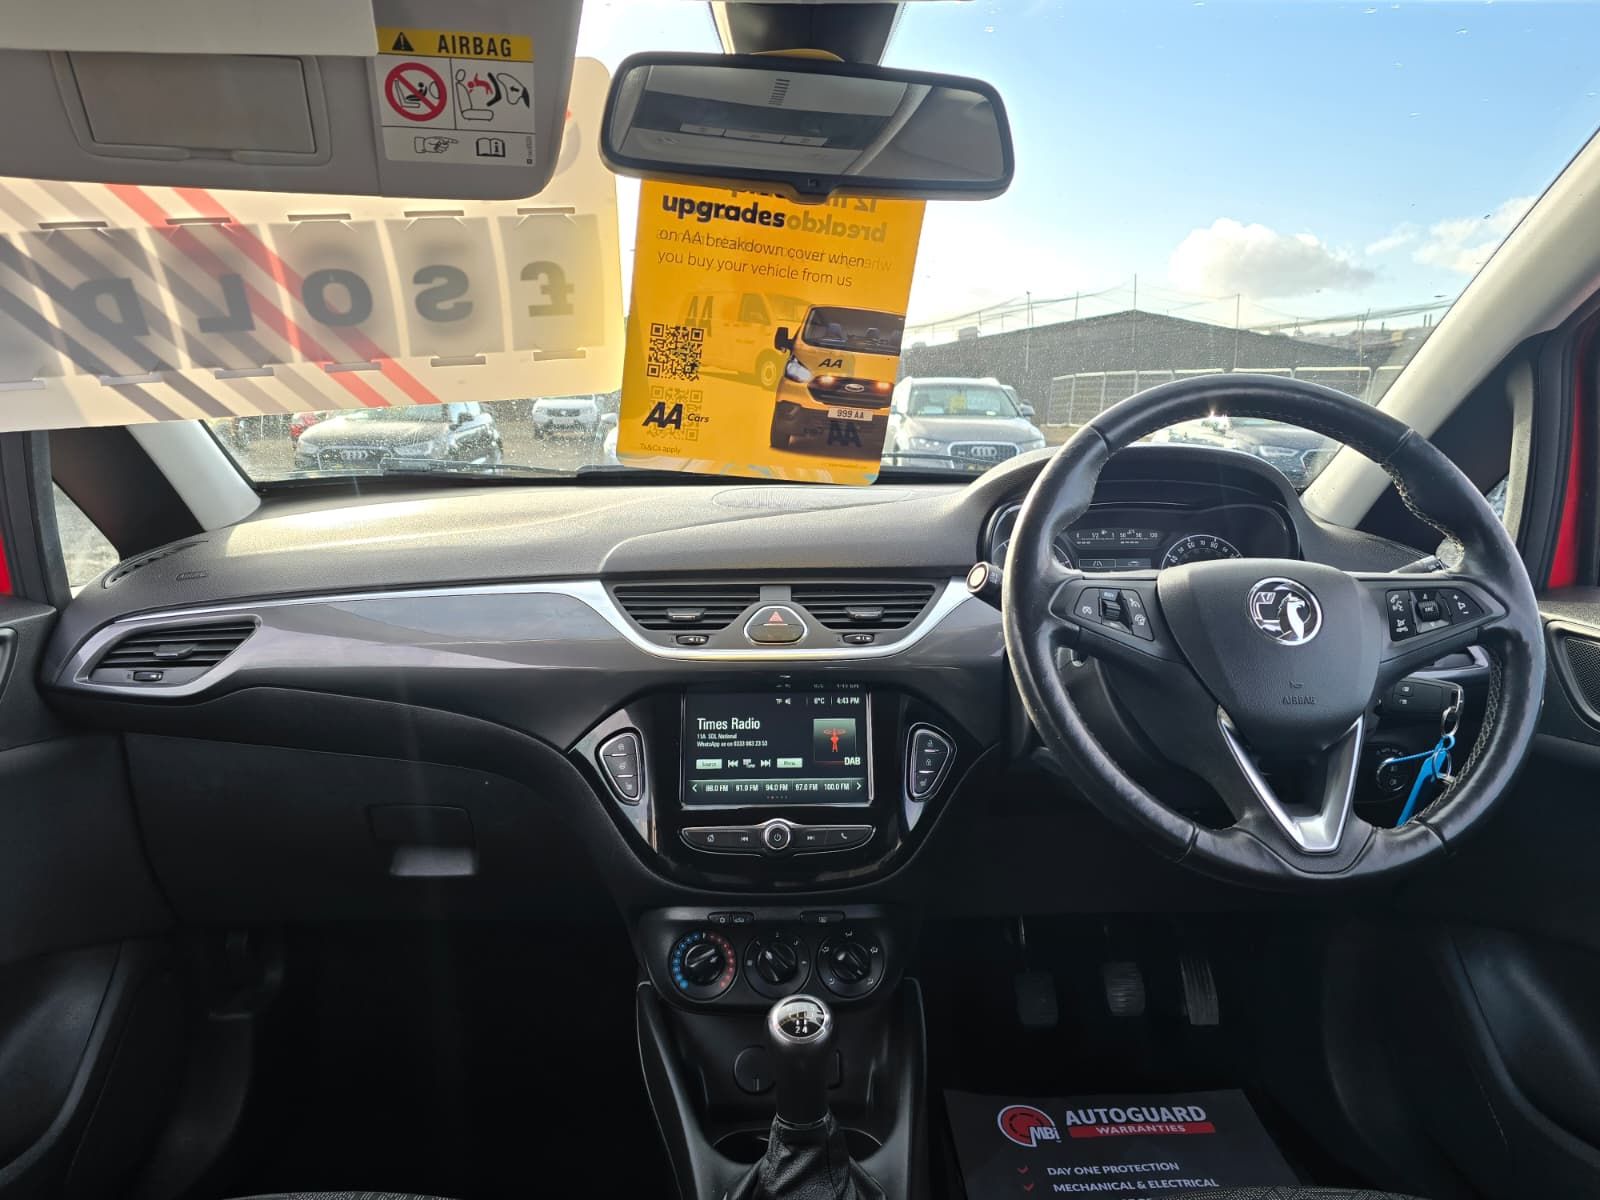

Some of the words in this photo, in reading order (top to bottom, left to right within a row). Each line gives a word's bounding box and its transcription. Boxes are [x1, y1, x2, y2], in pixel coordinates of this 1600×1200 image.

[437, 34, 512, 57] AIRBAG
[661, 193, 785, 229] upgrades
[659, 231, 679, 242] on
[682, 229, 702, 245] AA
[706, 231, 784, 258] breakdown
[787, 246, 825, 263] cover
[827, 250, 865, 269] when
[658, 250, 685, 266] you
[686, 250, 713, 270] buy
[715, 257, 748, 275] your
[749, 261, 800, 282] vehicle
[800, 267, 834, 285] from
[836, 274, 853, 288] us
[818, 358, 843, 369] AA
[641, 401, 684, 431] AA
[687, 412, 711, 423] Cars
[836, 409, 853, 418] 999
[854, 411, 865, 419] AA
[662, 446, 682, 455] apply
[849, 697, 860, 705] PM
[696, 717, 729, 731] Times
[731, 716, 761, 731] Radio
[843, 756, 862, 766] DAB
[719, 784, 729, 792] FM
[749, 784, 759, 792] FM
[779, 783, 789, 791] FM
[809, 783, 819, 791] FM
[840, 783, 850, 791] FM
[1065, 1105, 1208, 1126] AUTOGUARD
[1095, 1124, 1187, 1136] WARRANTIES
[1047, 1166, 1072, 1176] DAY
[1073, 1165, 1102, 1175] ONE
[1102, 1161, 1181, 1175] PROTECTION
[1053, 1180, 1136, 1193] MECHANICAL
[1136, 1180, 1147, 1190] &
[1146, 1177, 1220, 1190] ELECTRICAL
